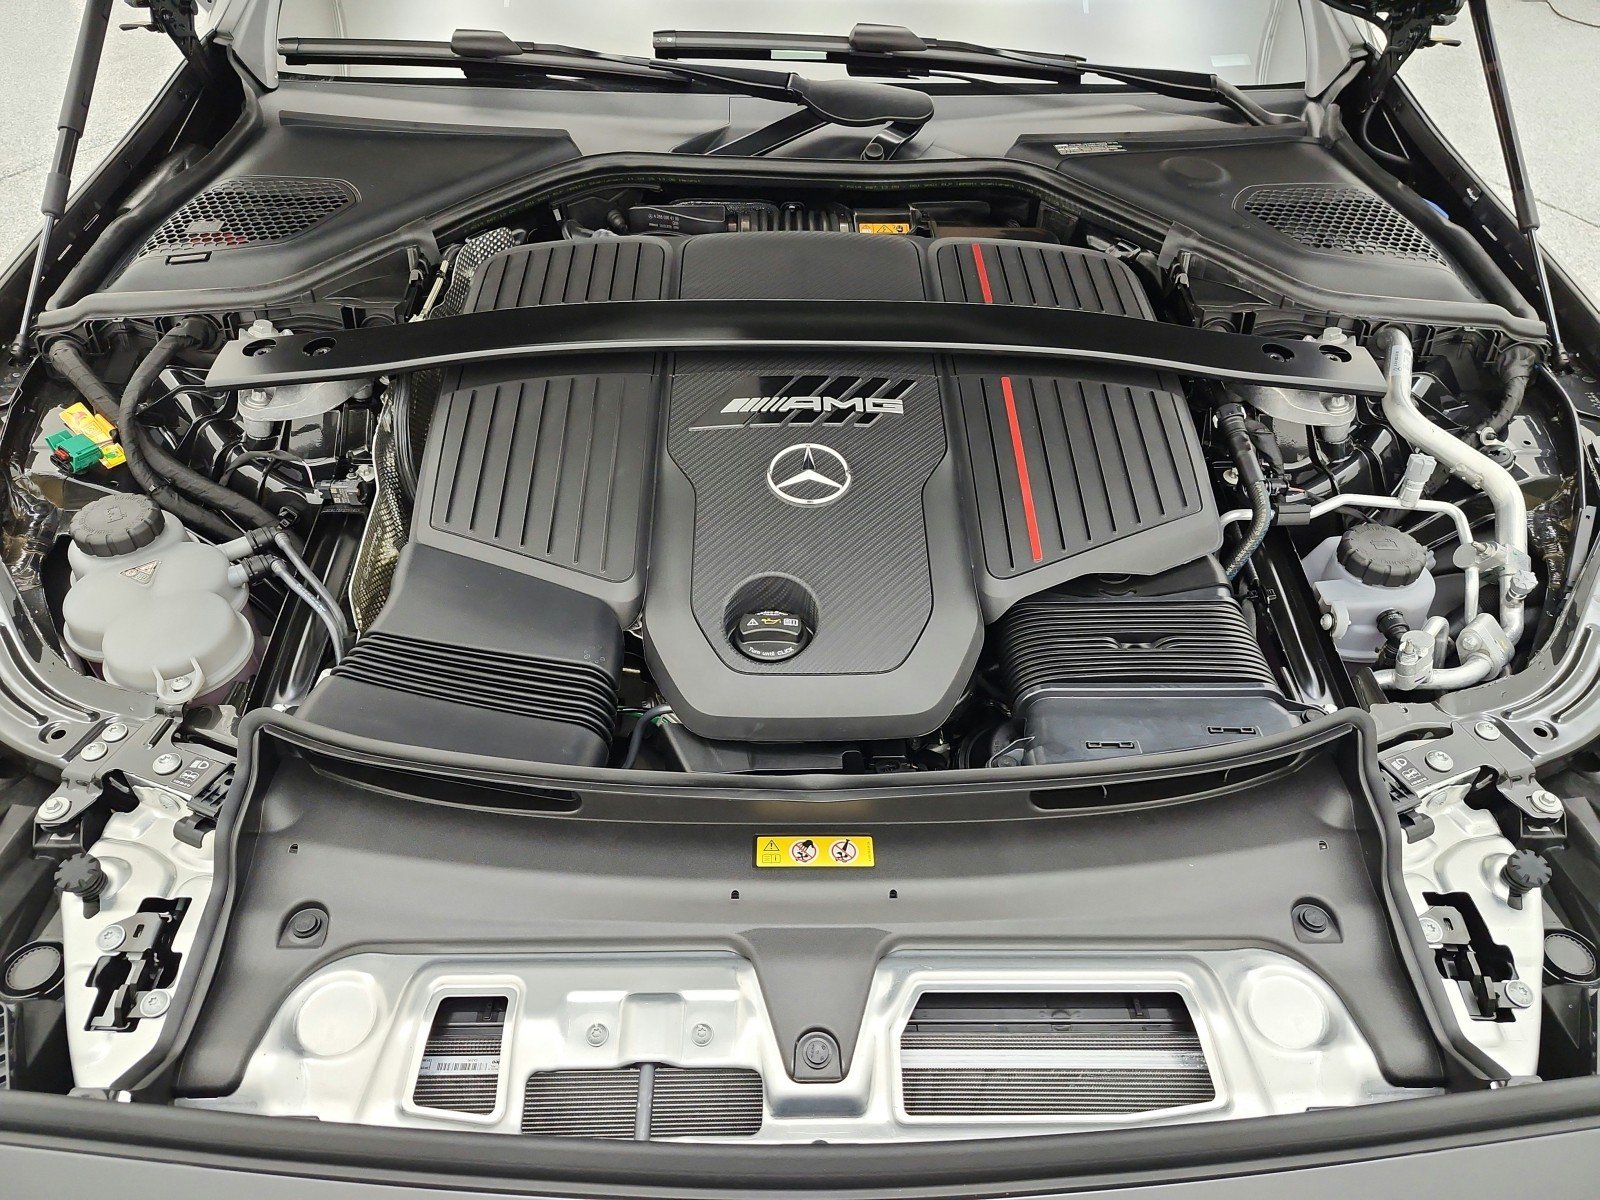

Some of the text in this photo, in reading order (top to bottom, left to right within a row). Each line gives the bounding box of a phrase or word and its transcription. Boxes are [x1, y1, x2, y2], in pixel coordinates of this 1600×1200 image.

[778, 396, 904, 414] AMG
[748, 646, 761, 655] Turn
[777, 646, 795, 656] CLICK
